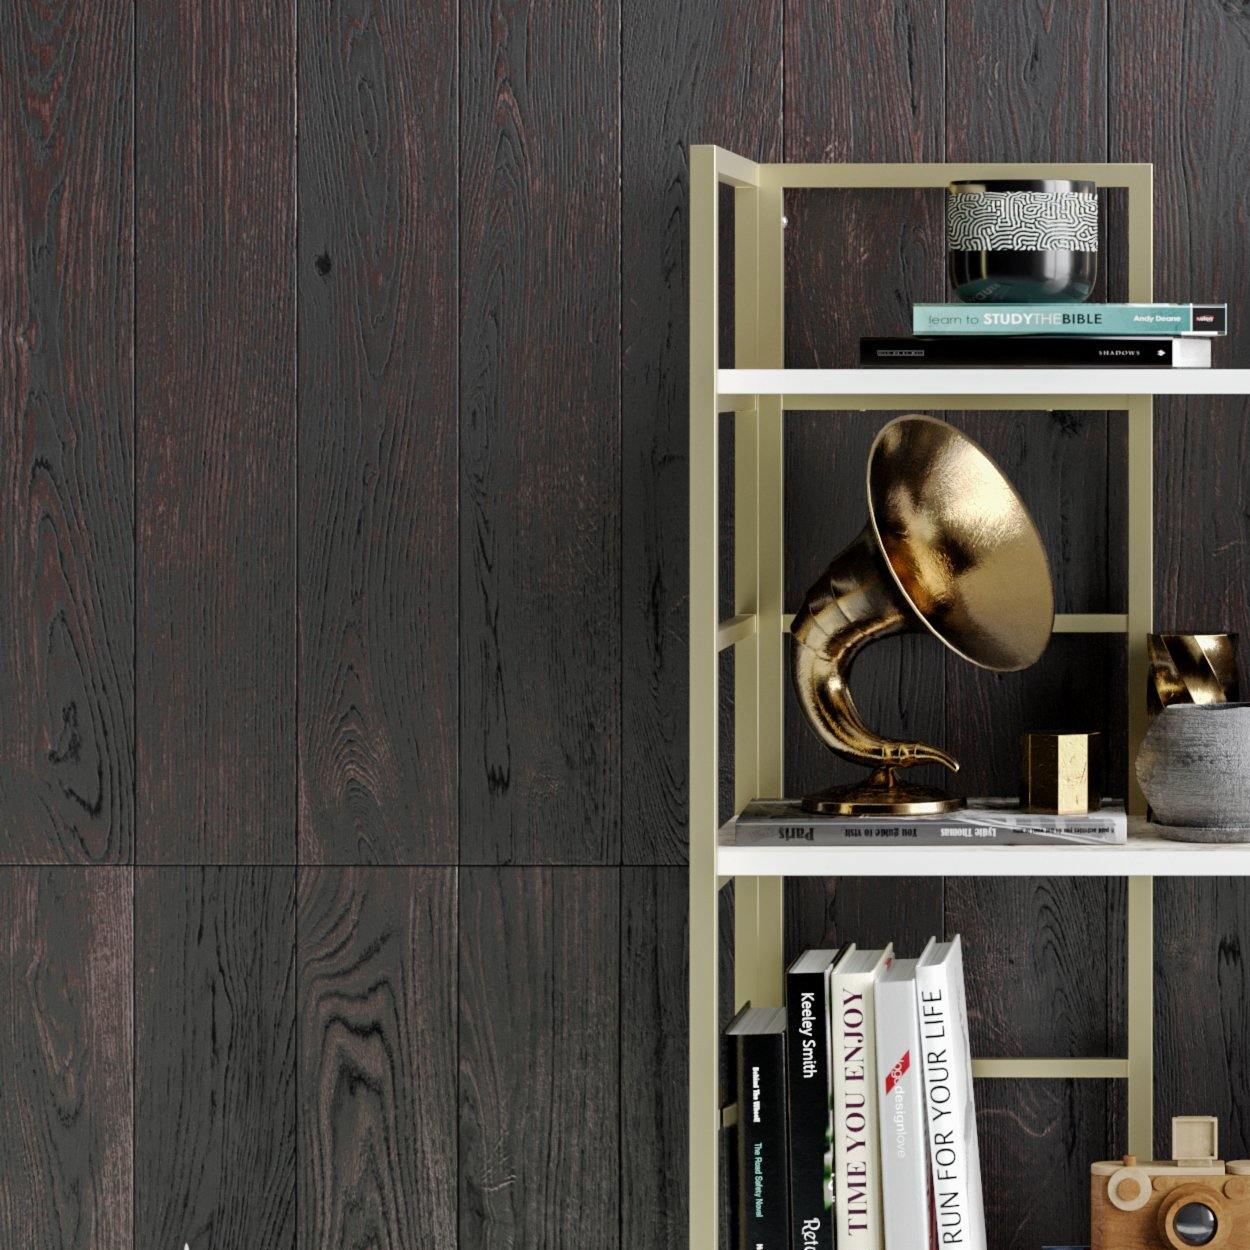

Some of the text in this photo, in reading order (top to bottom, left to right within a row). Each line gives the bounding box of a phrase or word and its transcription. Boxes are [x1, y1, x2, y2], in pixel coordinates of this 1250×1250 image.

[929, 313, 961, 325] learn
[966, 314, 979, 325] to
[1133, 315, 1154, 323] Andy
[778, 826, 815, 841] Paris
[864, 828, 873, 837] to
[940, 827, 973, 837] Thomas
[799, 992, 818, 1079] Keeley Smith
[842, 988, 868, 1236] TIME YOU ENJOY
[921, 988, 963, 1244] RUN FOR YOUR LIFE
[754, 1142, 764, 1218] The Road Safety Novel
